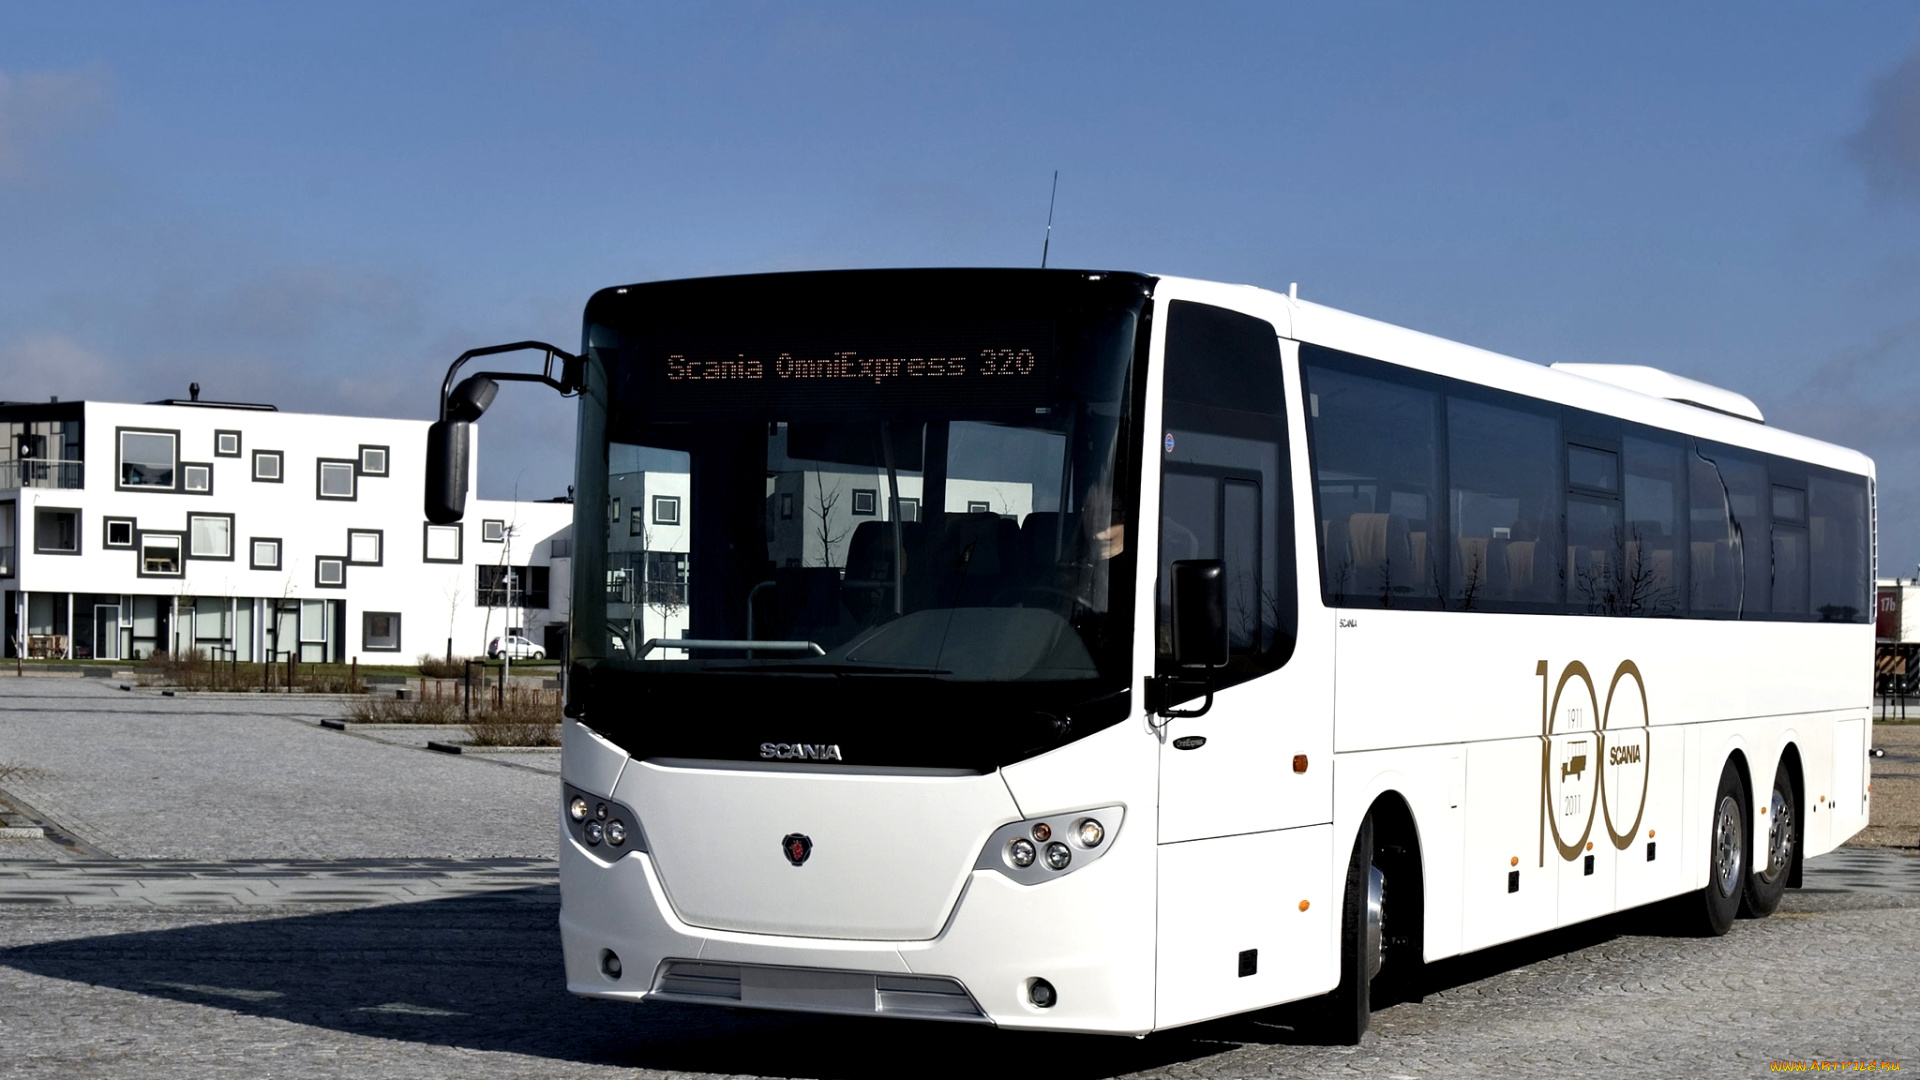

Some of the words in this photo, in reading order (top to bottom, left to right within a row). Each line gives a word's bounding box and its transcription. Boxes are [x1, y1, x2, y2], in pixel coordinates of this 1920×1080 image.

[667, 354, 763, 380] Scania
[776, 351, 966, 384] OmniExpress
[980, 349, 1035, 375] 320
[1568, 708, 1583, 729] 1911
[760, 742, 842, 761] SCANIA
[1610, 744, 1641, 766] SCANIA
[1535, 659, 1650, 867] 100
[1565, 794, 1581, 816] 2011
